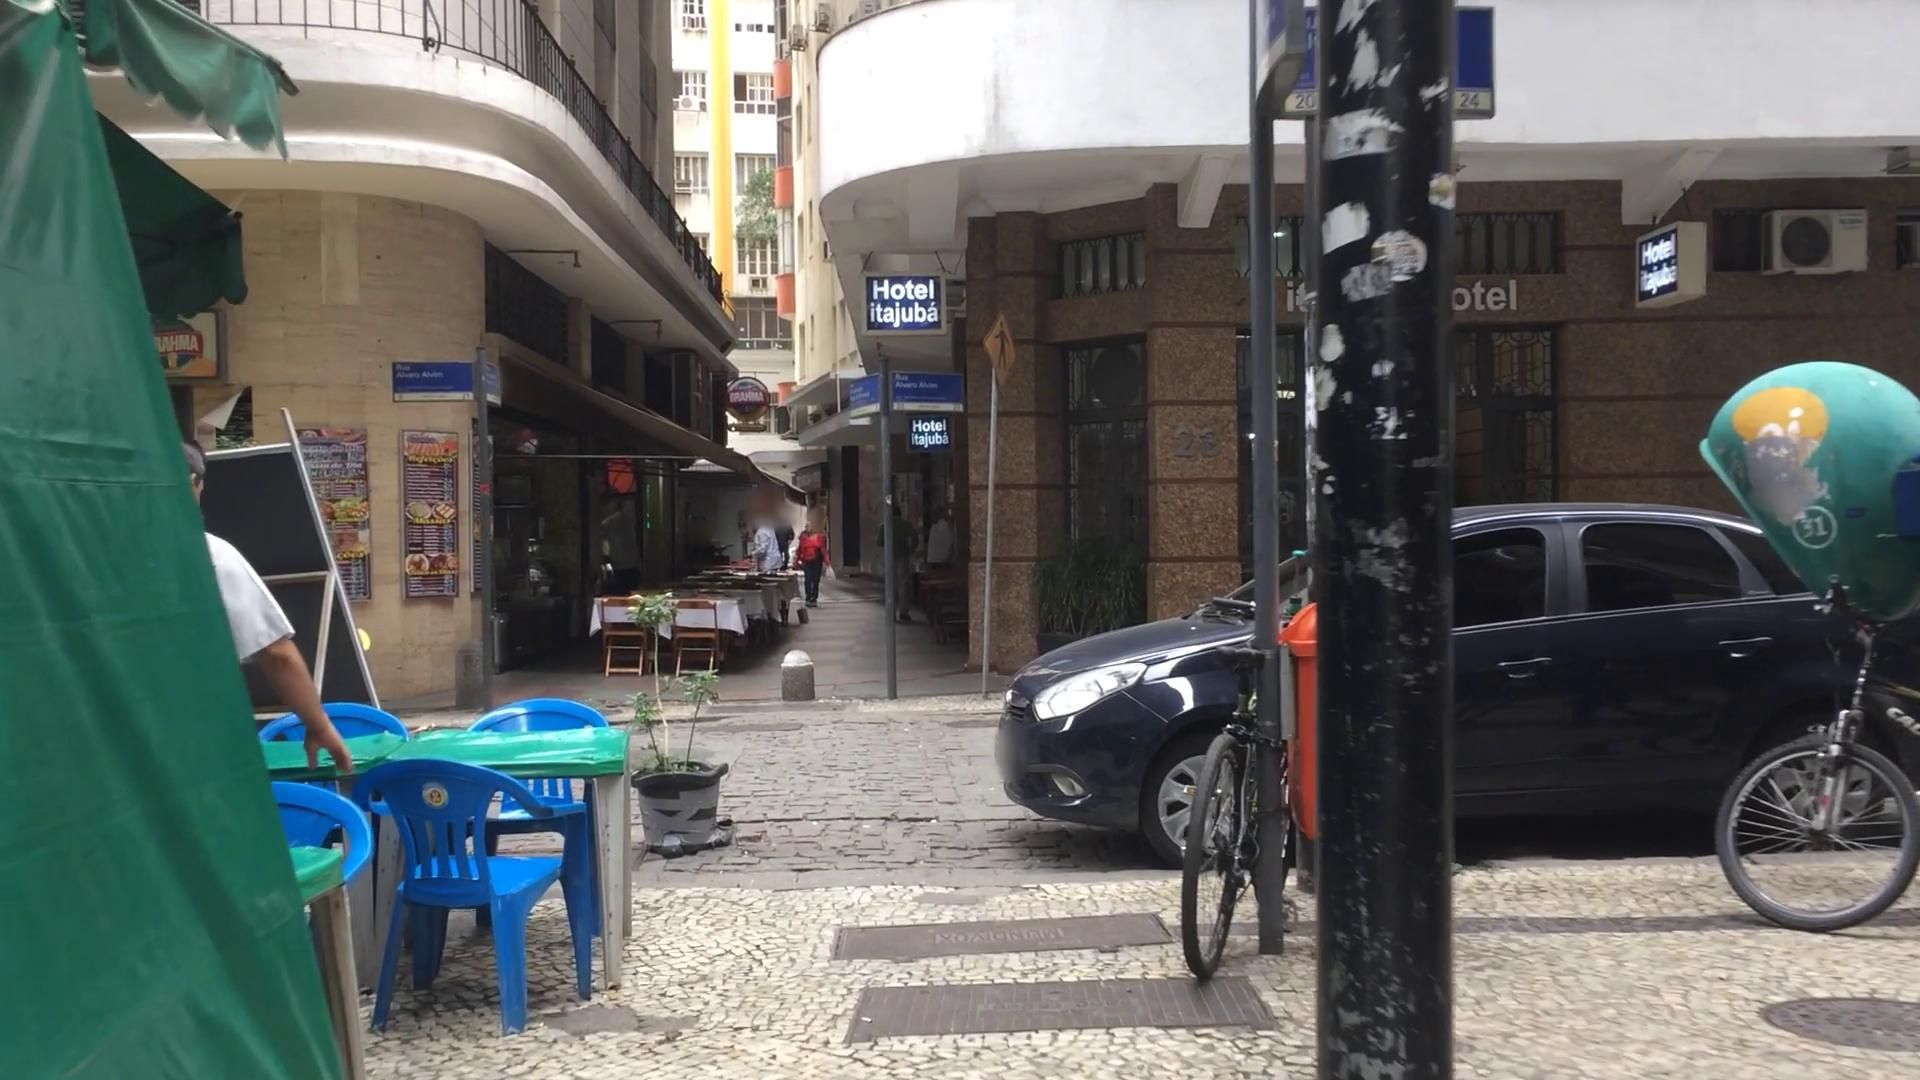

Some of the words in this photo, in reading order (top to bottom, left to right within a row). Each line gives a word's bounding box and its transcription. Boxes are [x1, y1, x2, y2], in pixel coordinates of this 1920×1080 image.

[1460, 93, 1480, 108] 24
[1642, 233, 1676, 267] Hotel
[872, 279, 935, 300] Hotel
[1451, 279, 1518, 311] otel
[870, 301, 939, 328] itajubá
[155, 334, 199, 352] RAHMA
[729, 391, 764, 403] BRAHMA
[912, 419, 947, 432] Hotel
[911, 432, 950, 448] itajubá
[1801, 516, 1829, 538] 31
